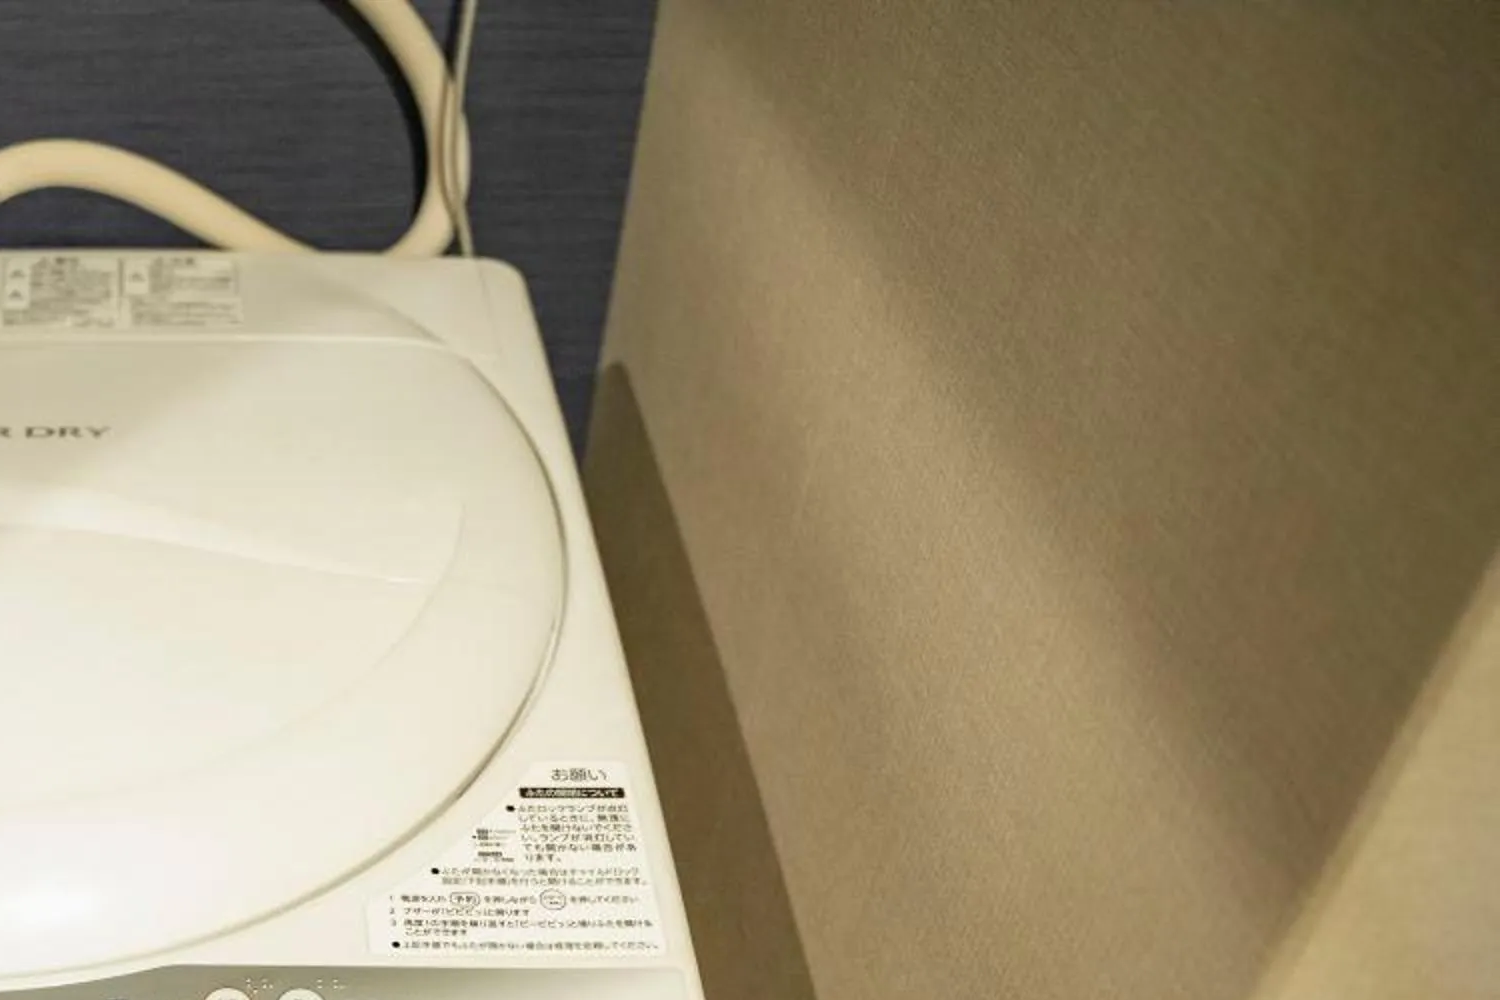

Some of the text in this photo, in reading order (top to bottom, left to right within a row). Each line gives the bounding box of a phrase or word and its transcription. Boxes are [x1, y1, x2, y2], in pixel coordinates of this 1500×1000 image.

[25, 426, 112, 440] DRY
[551, 767, 607, 782] お願い
